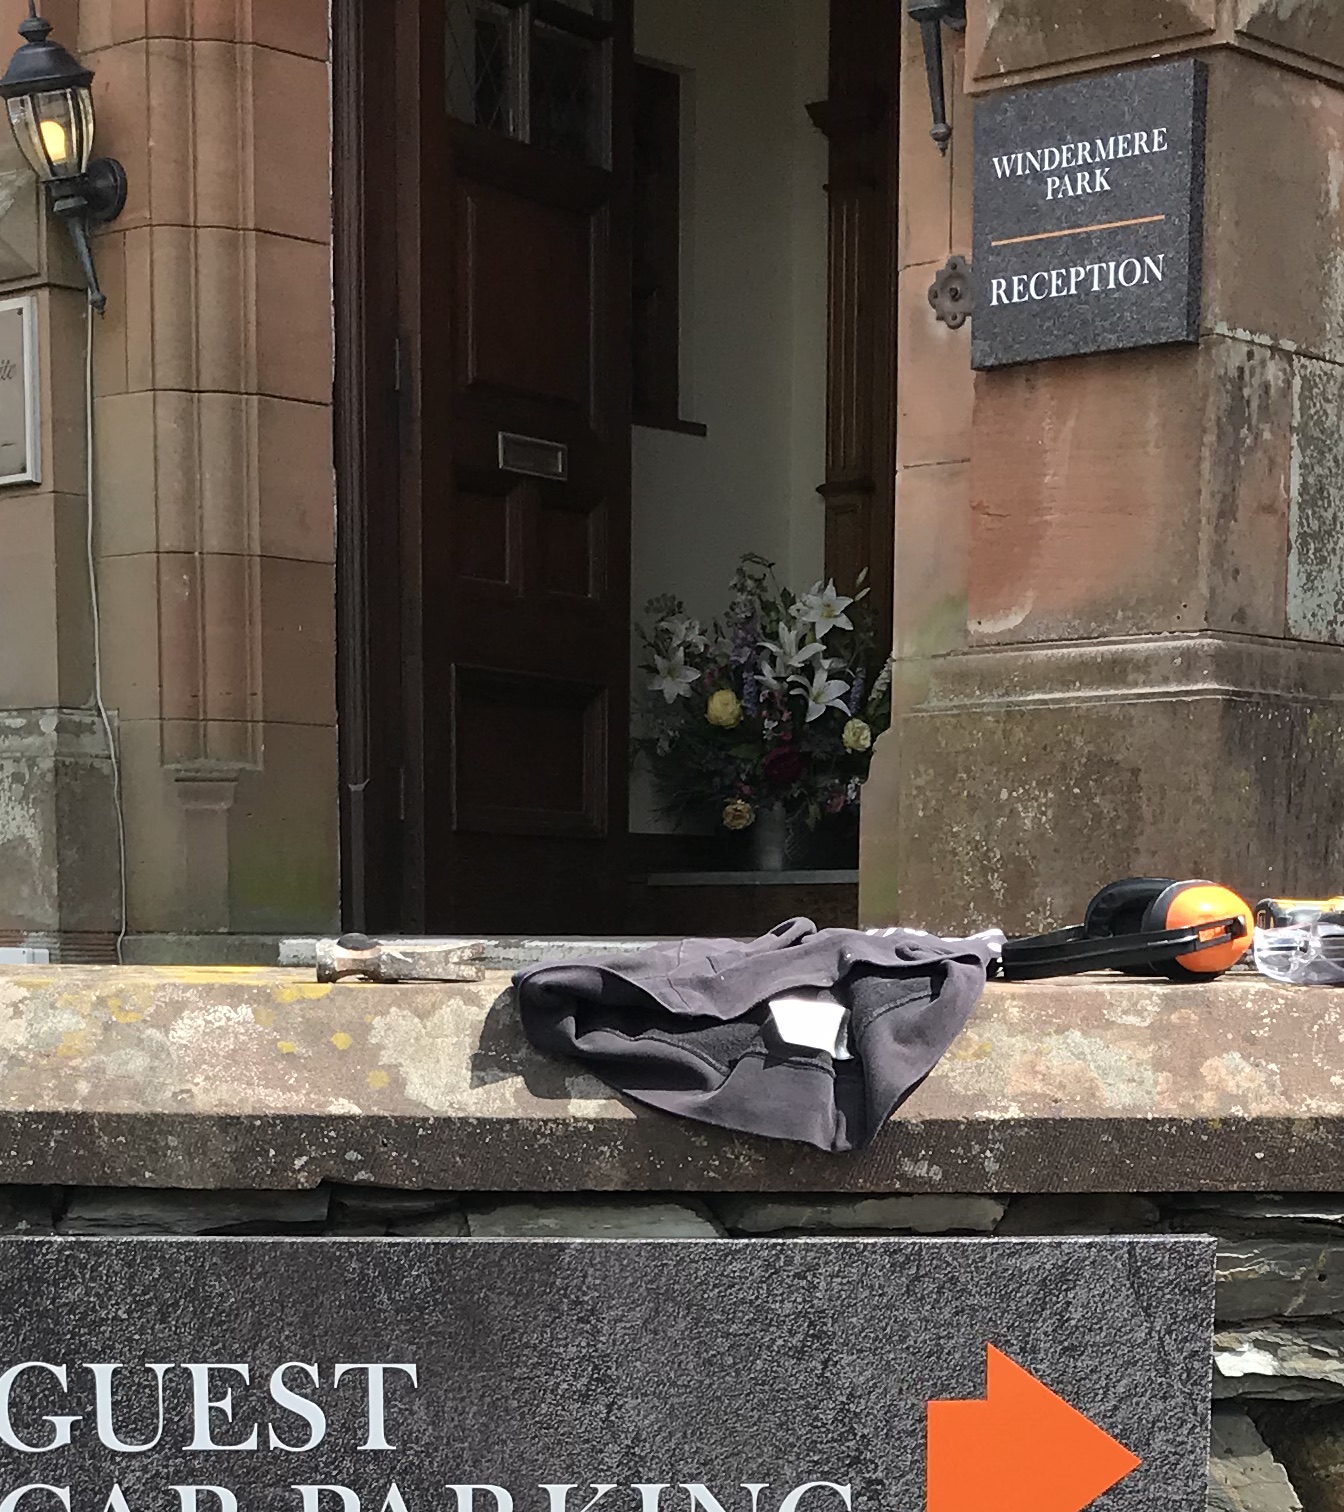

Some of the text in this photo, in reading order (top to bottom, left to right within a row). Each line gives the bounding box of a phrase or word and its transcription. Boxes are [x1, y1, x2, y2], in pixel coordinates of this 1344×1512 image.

[992, 127, 1168, 179] WINDERMERE
[1045, 167, 1111, 200] PARK
[989, 254, 1165, 306] RECEPTION
